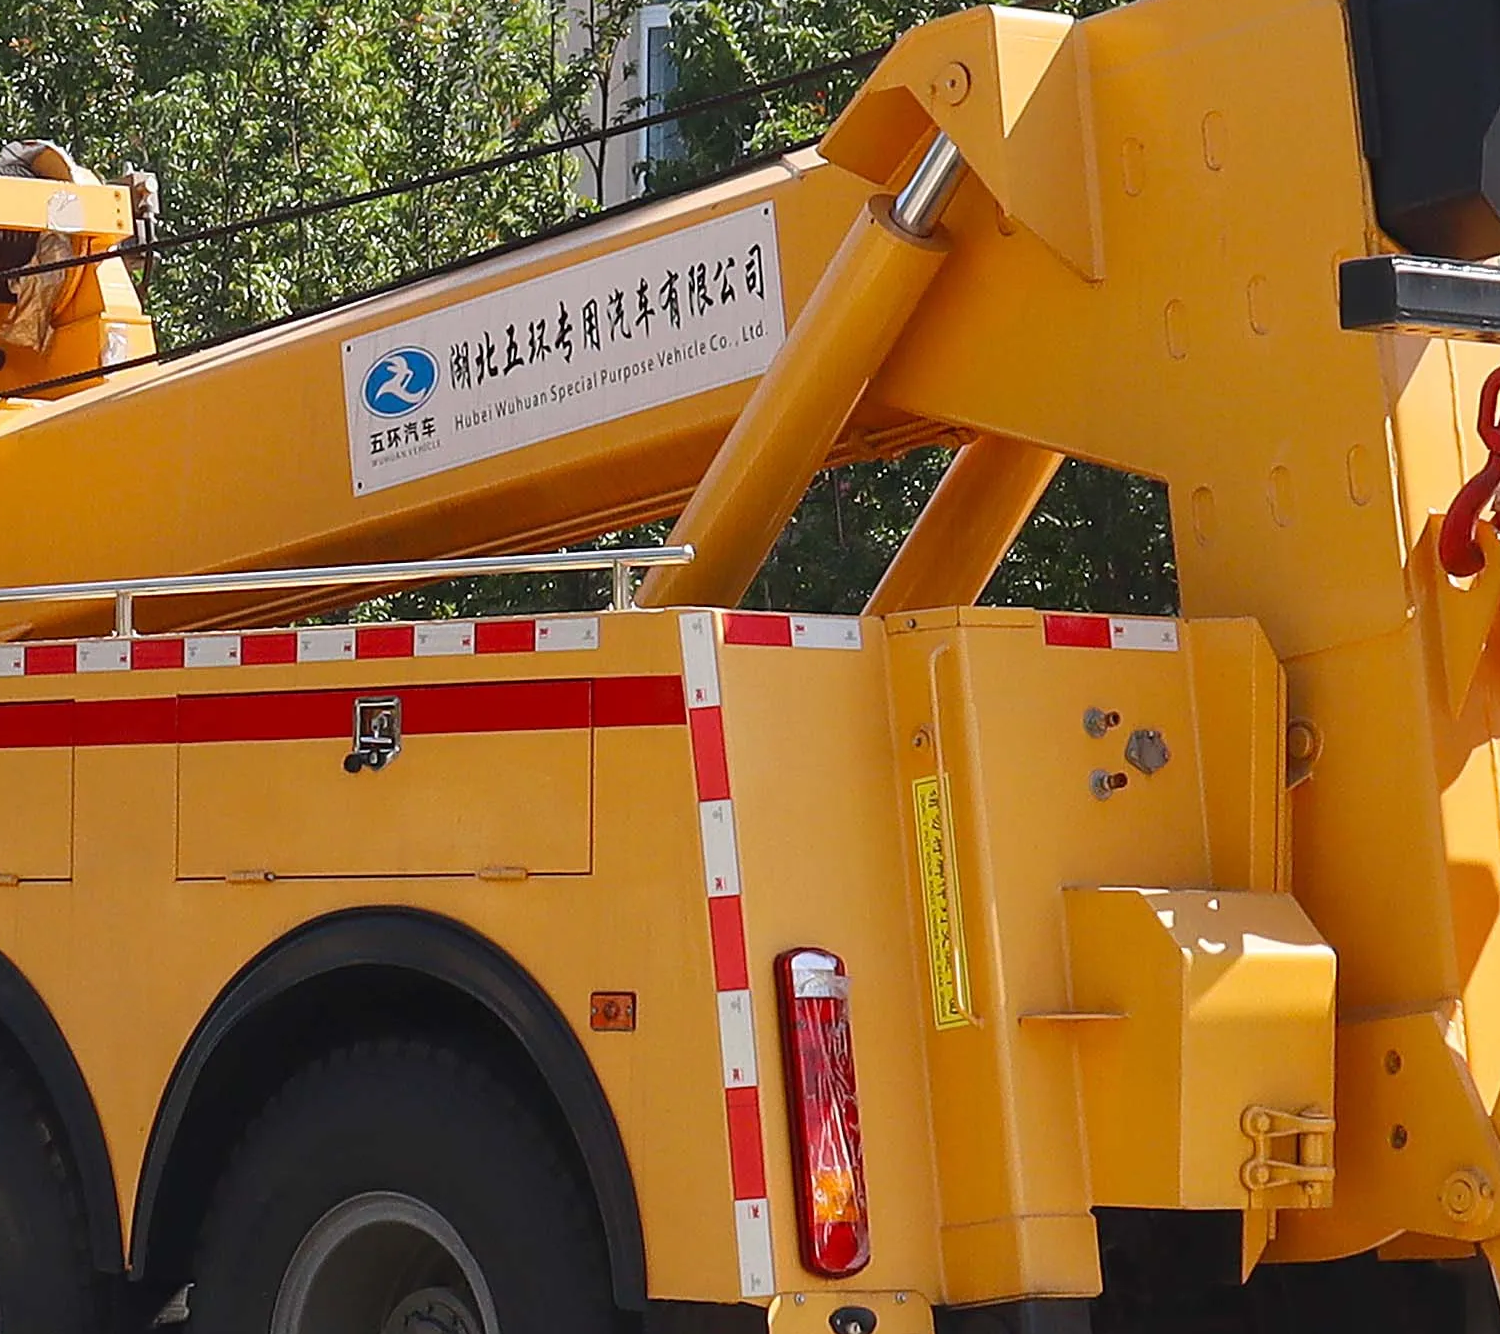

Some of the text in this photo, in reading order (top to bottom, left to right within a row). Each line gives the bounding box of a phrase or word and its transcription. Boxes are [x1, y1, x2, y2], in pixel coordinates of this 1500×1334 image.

[450, 243, 765, 390] 湖北五环专用汽车有限公司
[454, 407, 493, 431] Hubei
[494, 391, 548, 418] Wuhuan
[549, 371, 598, 404] Special
[600, 357, 654, 385] Purpose
[656, 340, 707, 367] Vehicle
[741, 320, 769, 343] Ltd.
[369, 417, 437, 455] 五环汽车
